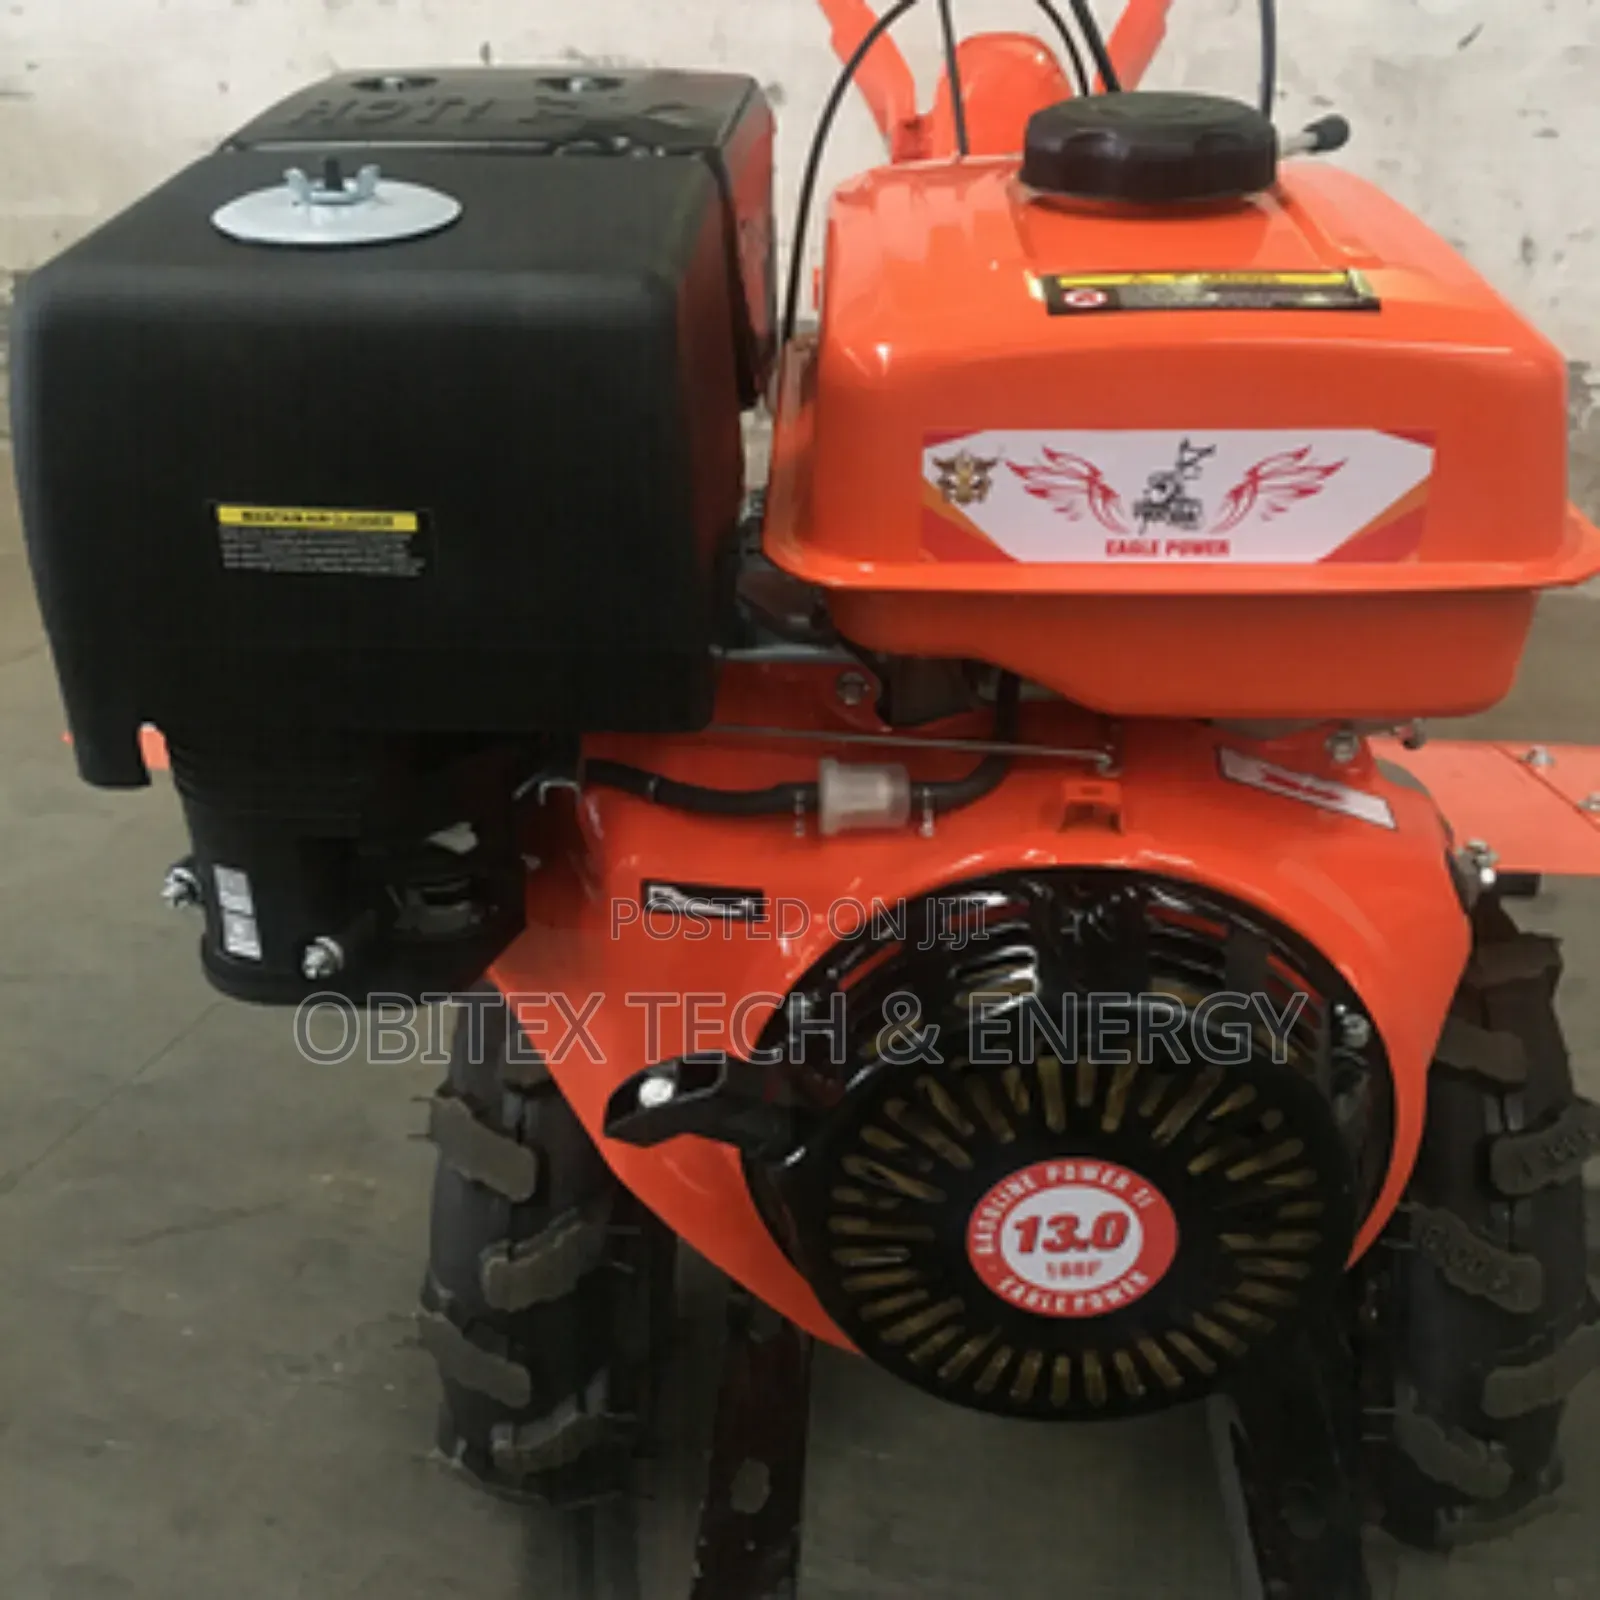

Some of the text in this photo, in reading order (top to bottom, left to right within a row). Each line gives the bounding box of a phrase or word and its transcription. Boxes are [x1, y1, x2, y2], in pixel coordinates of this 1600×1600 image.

[1105, 538, 1230, 557] EAGLE POWER
[1046, 1165, 1130, 1190] POWER
[1013, 1211, 1130, 1254] 13.0
